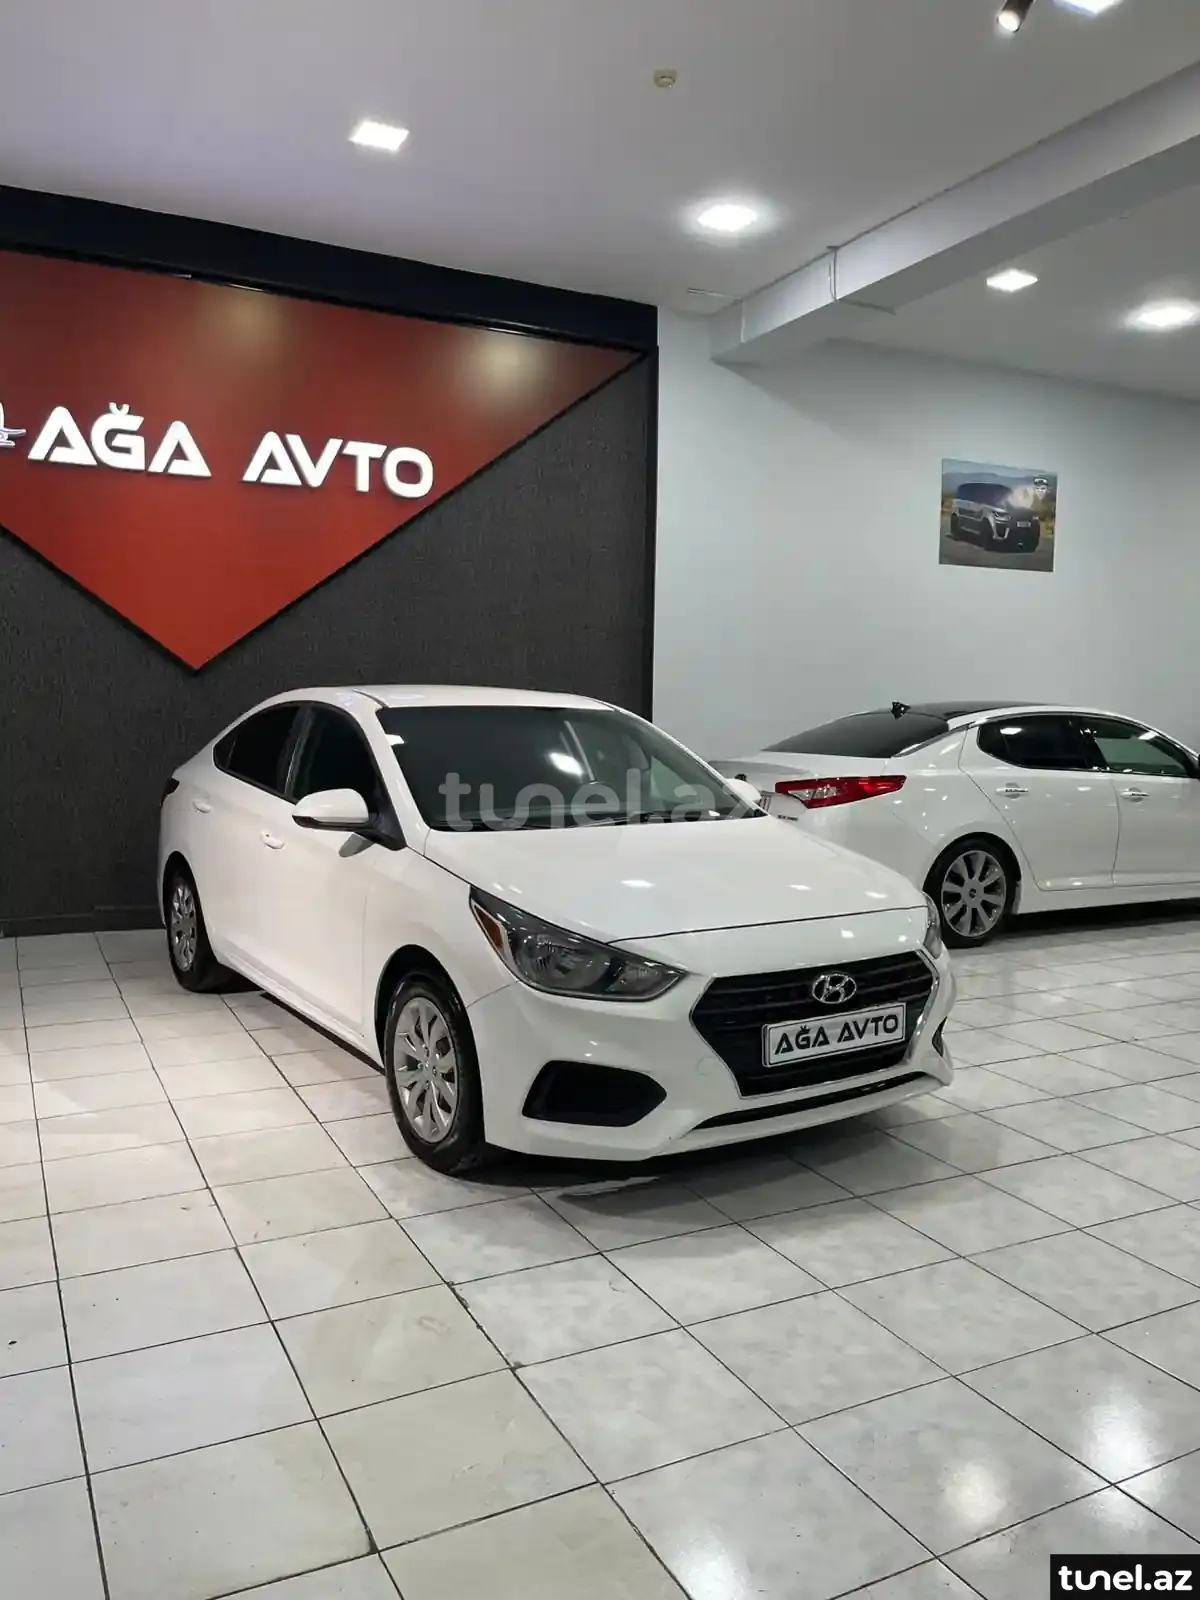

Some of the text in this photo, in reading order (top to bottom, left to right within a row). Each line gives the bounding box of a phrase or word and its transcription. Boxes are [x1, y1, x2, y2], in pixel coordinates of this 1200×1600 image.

[28, 402, 434, 498] AĞA AVTO
[774, 1014, 899, 1056] AĞA AVTO
